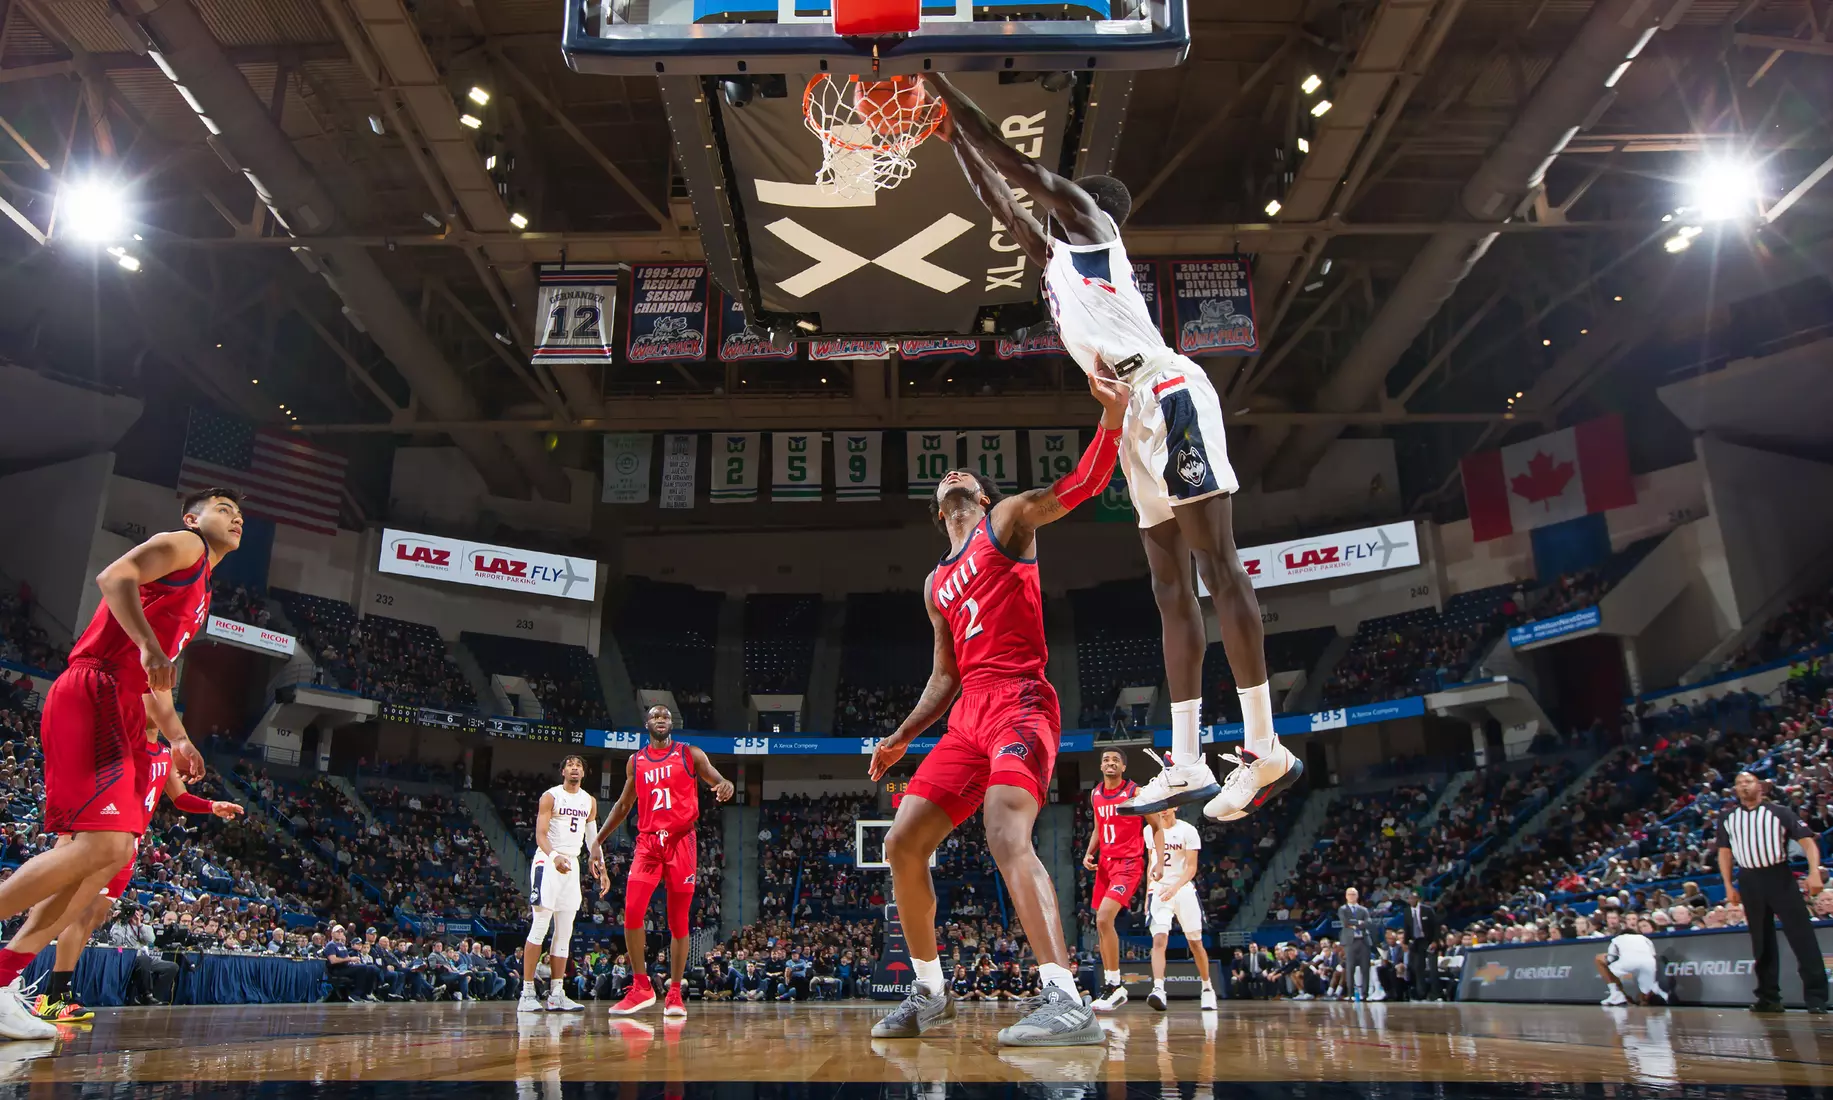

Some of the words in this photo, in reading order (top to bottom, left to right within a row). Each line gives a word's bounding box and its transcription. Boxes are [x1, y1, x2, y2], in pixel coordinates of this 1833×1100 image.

[637, 267, 704, 279] 1999-2000
[985, 255, 1026, 292] XL
[1181, 263, 1240, 272] 2014-2015
[1176, 272, 1246, 280] NORTHEAST
[641, 279, 697, 290] REGULAR
[1185, 280, 1238, 289] DIVISION
[645, 290, 693, 302] SEASON
[1178, 288, 1248, 298] CHAMPIONS
[634, 302, 703, 314] CHAMPIONS
[548, 305, 601, 339] 12
[727, 457, 743, 484] 2
[788, 456, 807, 481] 5
[849, 455, 866, 482] 9
[917, 454, 948, 479] 10
[978, 453, 1006, 479] 11
[1039, 456, 1072, 483] 19
[397, 544, 450, 566] LAZ
[1285, 546, 1339, 569] LAZ
[1345, 541, 1378, 560] FLY
[415, 563, 449, 571] PARKING
[474, 555, 527, 577] LAZ
[531, 565, 563, 582] FLY
[1287, 566, 1319, 575] AIRPORT
[1320, 562, 1352, 571] PARKING
[475, 572, 505, 581] AIRPORT
[507, 576, 536, 585] PARKING
[938, 551, 978, 609] NJIT
[1410, 586, 1429, 598] 240
[376, 594, 394, 605] 232
[516, 619, 534, 630] 233
[959, 597, 984, 642] 2
[1261, 613, 1279, 624] 239
[216, 620, 245, 633] RICOH
[261, 631, 289, 644] RICOH
[447, 714, 454, 723] 6
[494, 721, 503, 730] 12
[794, 742, 819, 750] Company
[152, 762, 168, 782] JIT
[644, 764, 672, 786] NJIT
[145, 787, 156, 812] 4
[651, 787, 672, 811] 21
[559, 807, 588, 817] UCONN
[570, 817, 579, 833] 5
[1103, 824, 1116, 844] 11
[1163, 852, 1171, 867] 2
[1515, 965, 1572, 979] CHEVROLET
[1665, 960, 1756, 977] CHEVROLET
